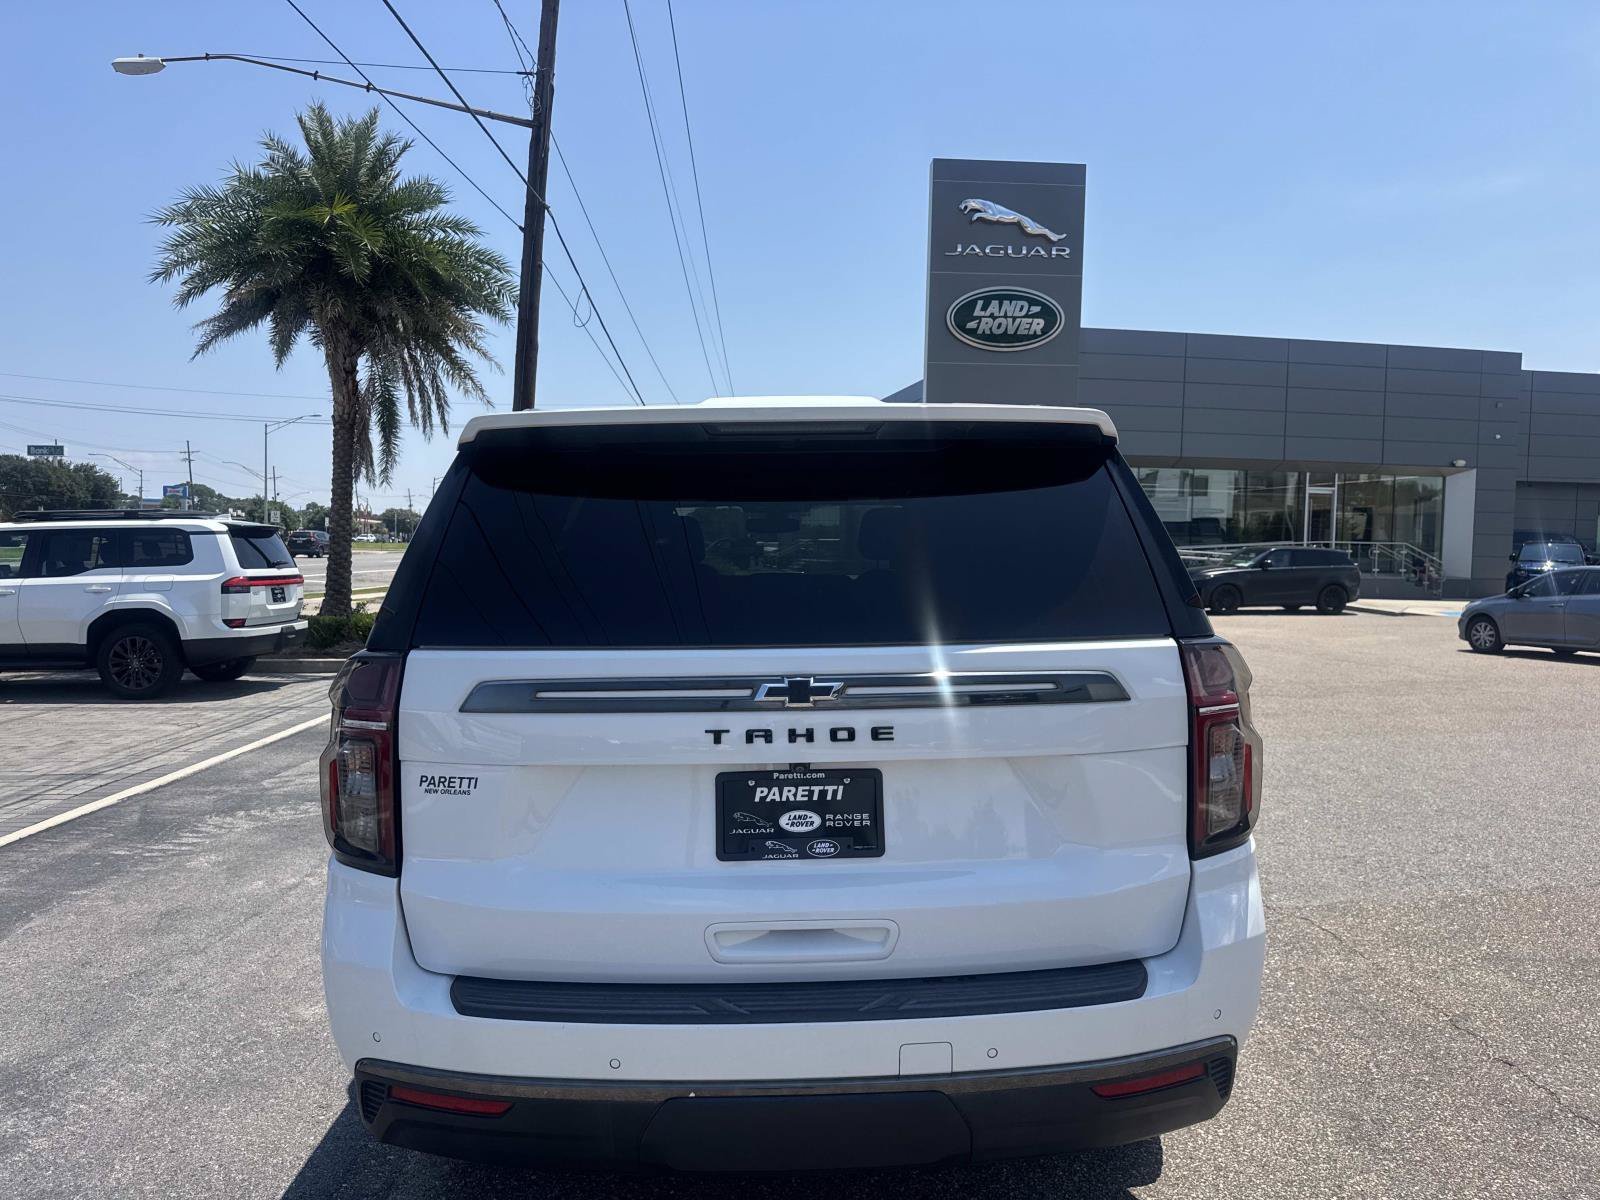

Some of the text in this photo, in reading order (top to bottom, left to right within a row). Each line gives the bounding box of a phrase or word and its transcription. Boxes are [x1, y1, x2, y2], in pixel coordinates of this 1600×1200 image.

[944, 243, 1071, 258] JAGUAR
[973, 300, 1029, 317] LAND
[977, 318, 1045, 335] ROVER
[704, 725, 895, 745] TAHOE
[419, 775, 479, 789] PARETTI
[773, 772, 826, 780] Paretti.com
[754, 785, 844, 803] PARETTI
